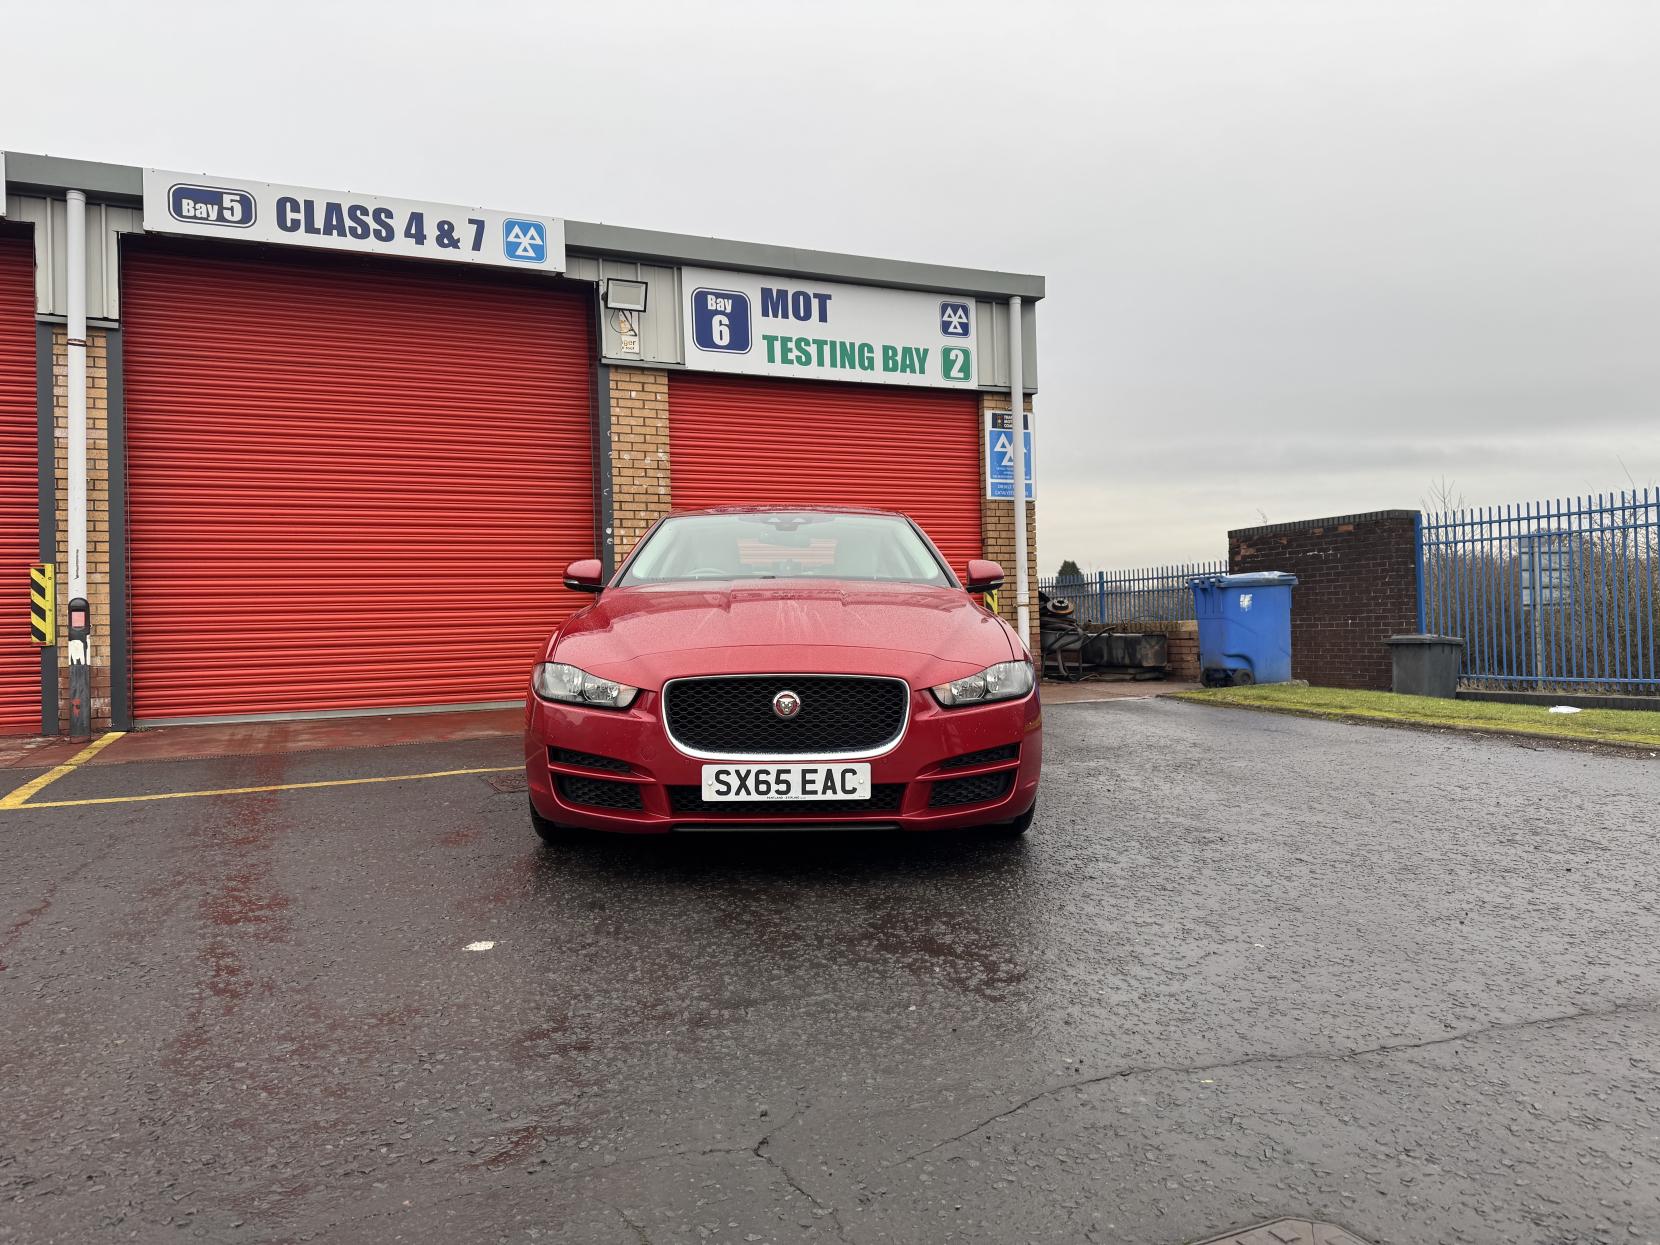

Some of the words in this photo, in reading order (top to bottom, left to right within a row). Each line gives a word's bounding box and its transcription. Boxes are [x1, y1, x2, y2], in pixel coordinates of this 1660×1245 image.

[181, 198, 218, 221] Bay
[222, 193, 242, 222] 5
[276, 196, 395, 243] CLASS
[404, 211, 427, 246] 4
[435, 220, 461, 250] &
[468, 218, 485, 252] 7
[707, 294, 732, 313] Bay
[760, 286, 832, 323] MOT
[711, 314, 730, 346] 6
[762, 334, 875, 371] TESTING
[882, 344, 930, 375] BAY
[949, 349, 965, 378] 2
[714, 769, 792, 796] SX65
[801, 768, 858, 795] EAC
